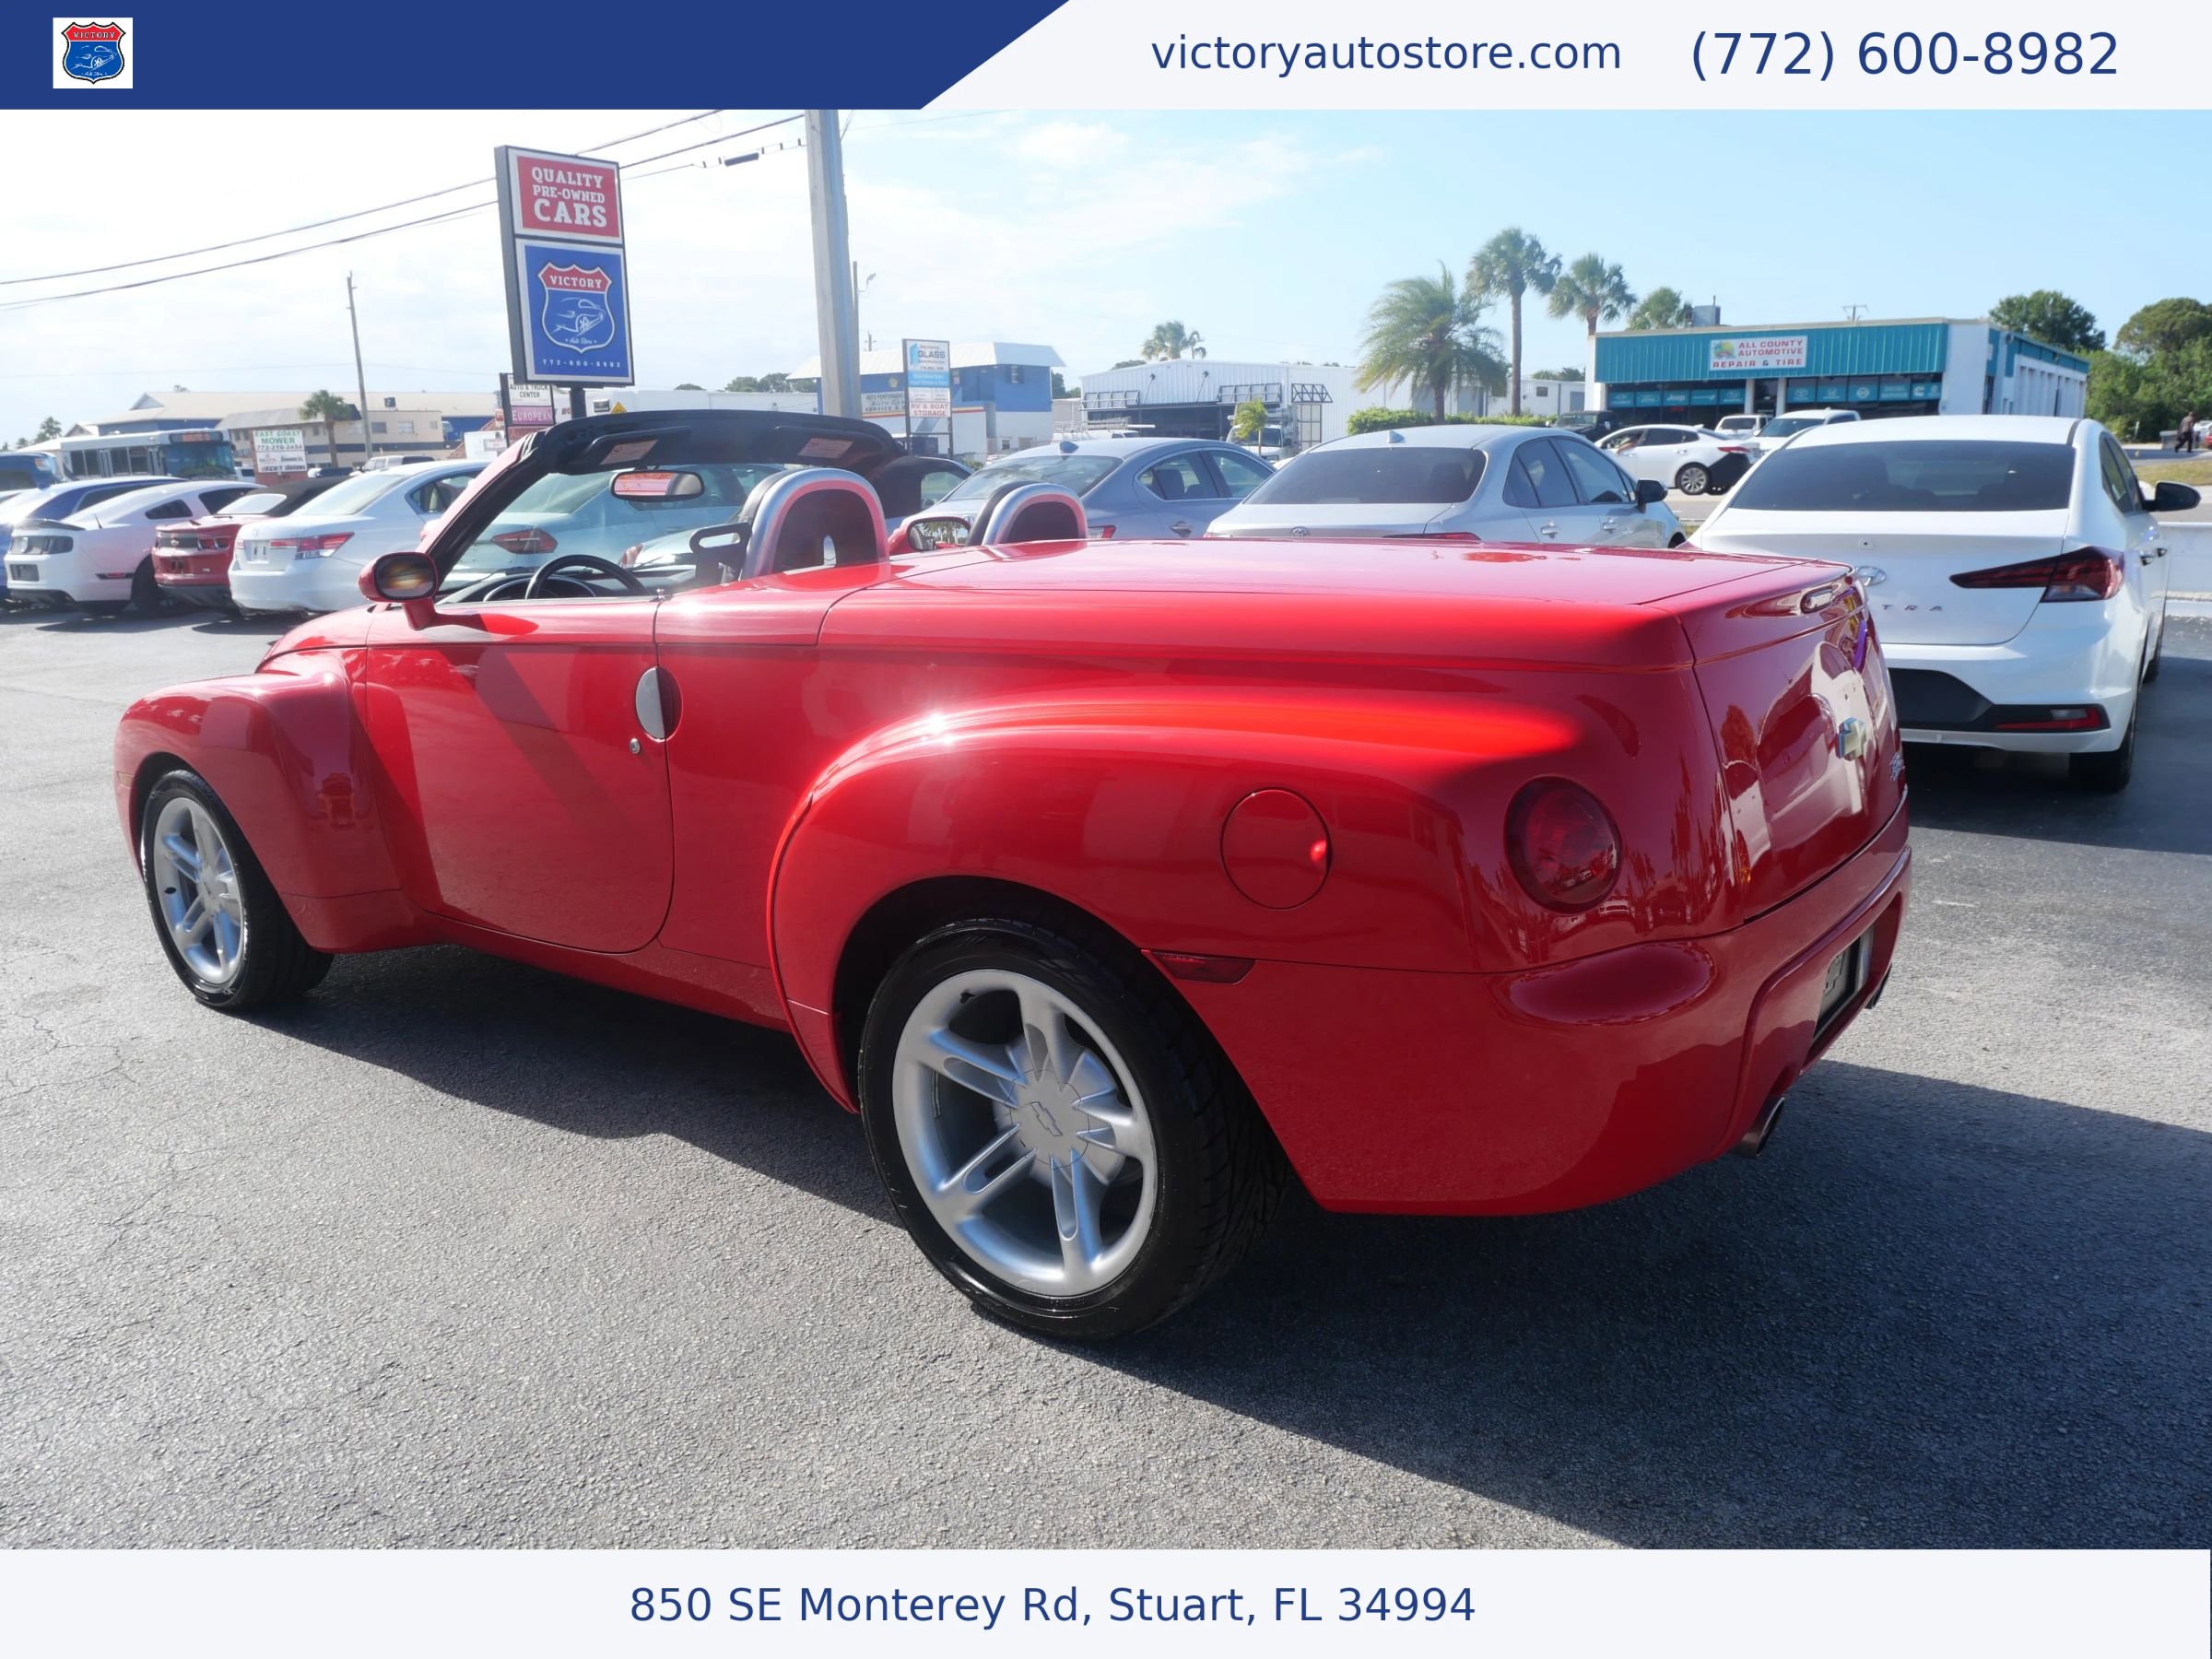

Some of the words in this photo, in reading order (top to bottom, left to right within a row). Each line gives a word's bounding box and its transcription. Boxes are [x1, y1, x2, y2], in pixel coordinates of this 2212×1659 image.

[532, 167, 604, 189] QUALITY
[532, 184, 606, 204] PRE-OWNED
[534, 198, 607, 228] CARS
[549, 275, 603, 289] VICTORY
[1760, 339, 1804, 347] COUNTY
[917, 350, 946, 359] GLASS
[1738, 347, 1804, 357] AUTOMOTIVE
[512, 409, 553, 421] EUROPEAN
